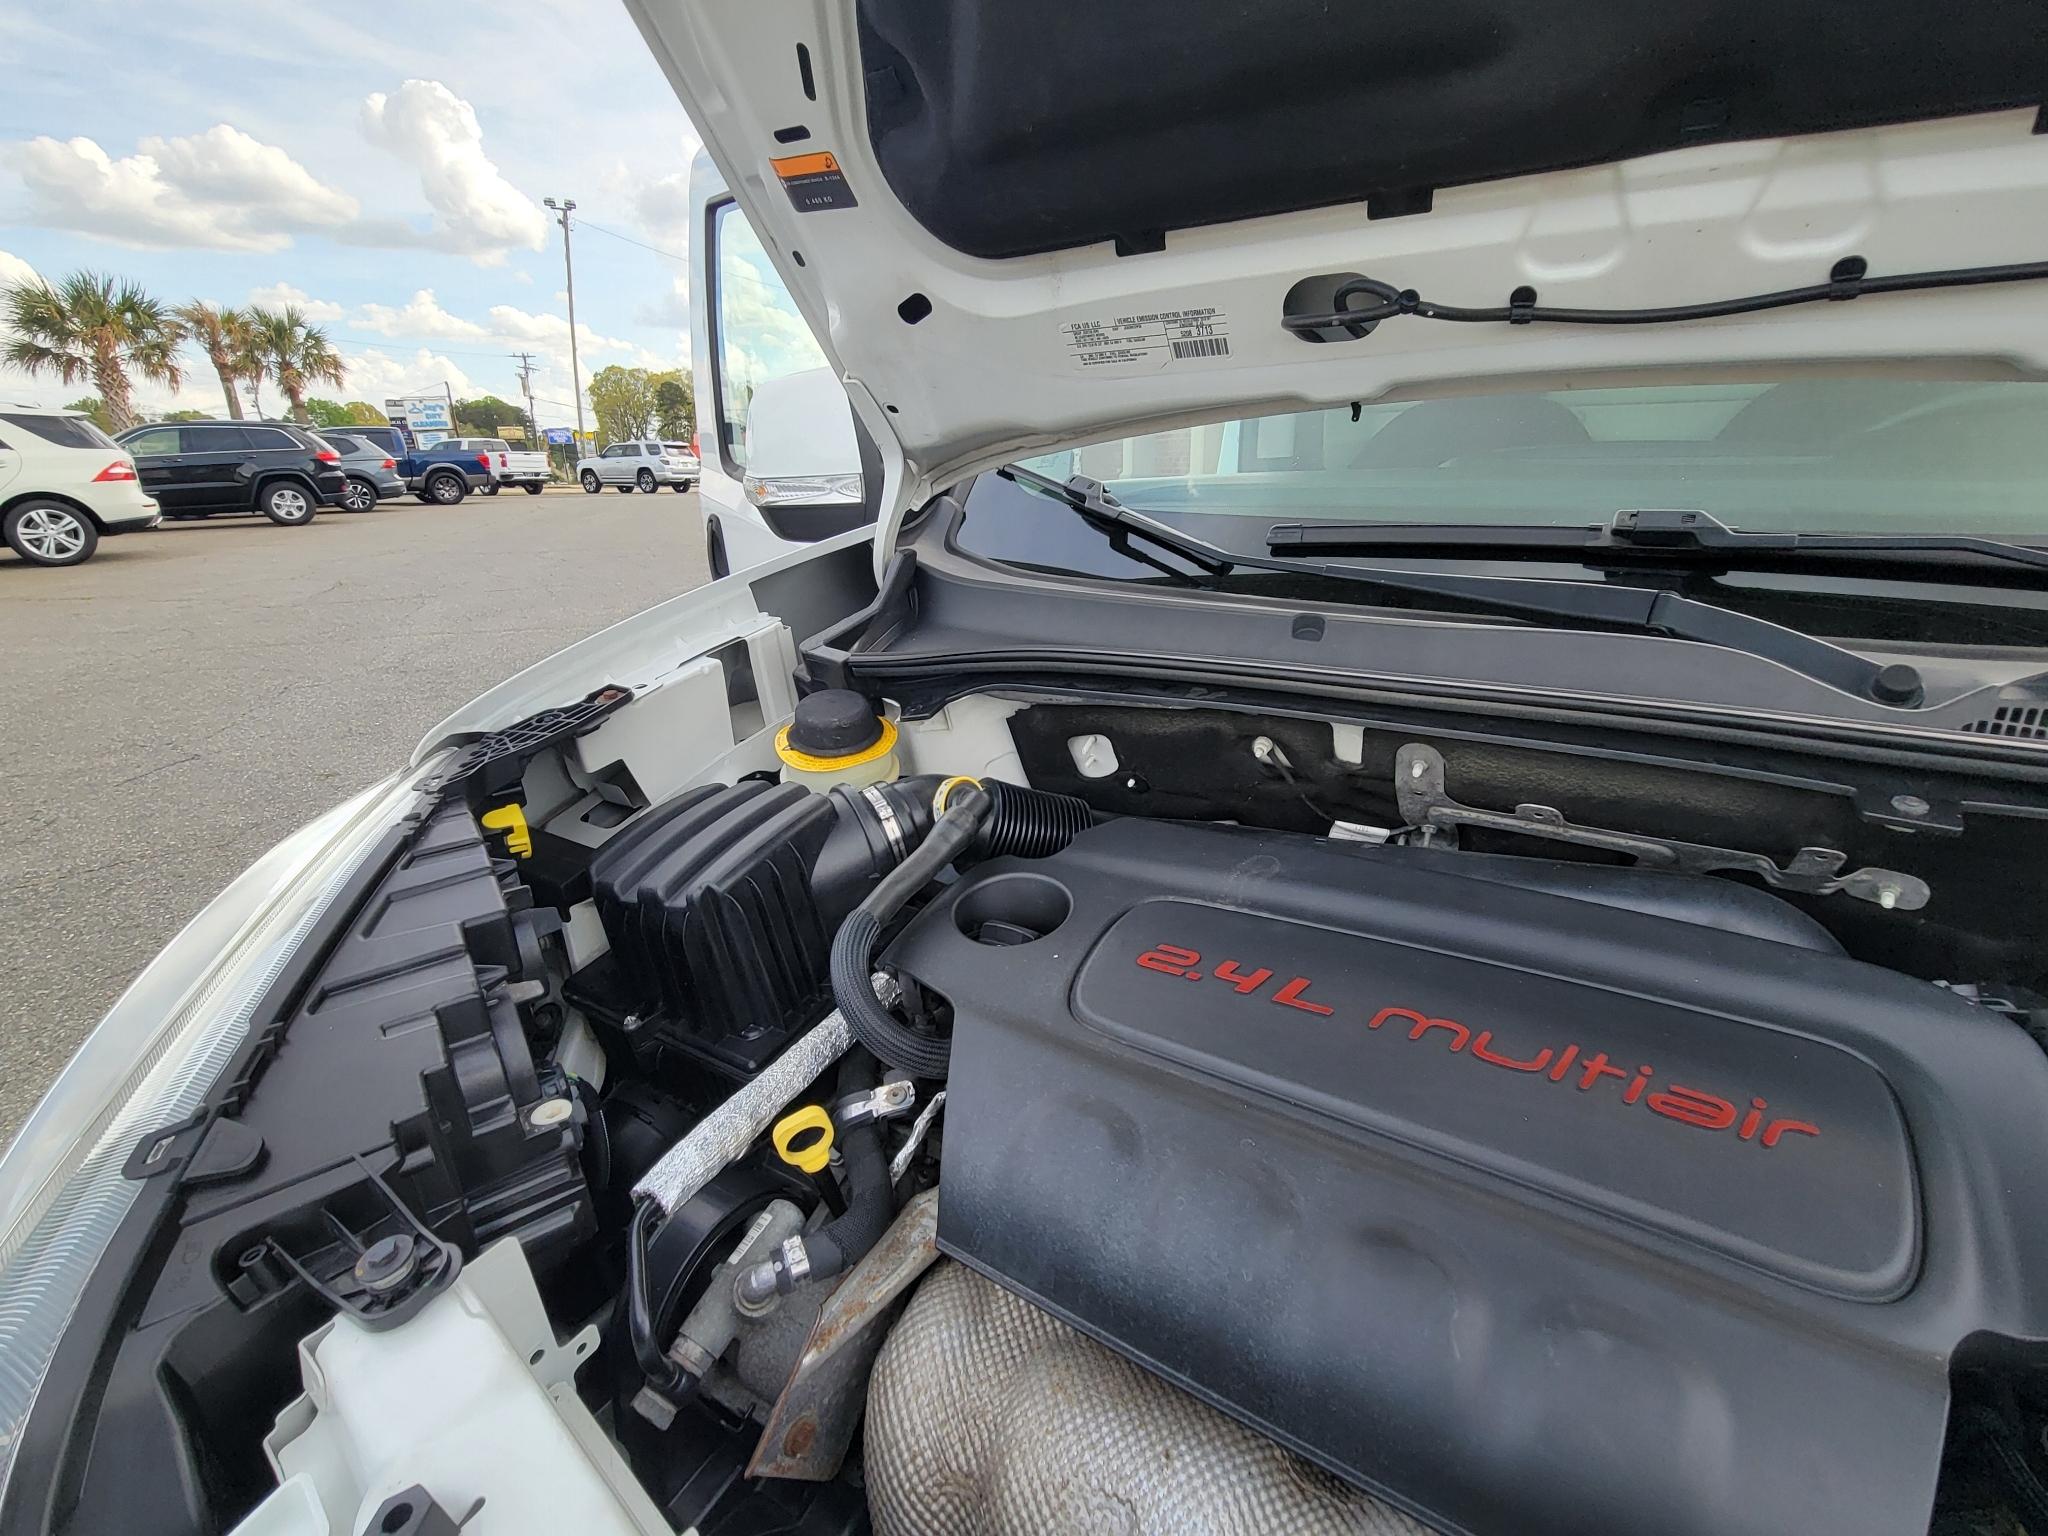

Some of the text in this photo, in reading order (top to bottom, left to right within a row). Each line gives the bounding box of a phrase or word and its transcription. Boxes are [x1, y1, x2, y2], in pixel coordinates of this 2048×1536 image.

[1091, 320, 1101, 328] LLC
[1116, 308, 1216, 325] VEHICLE EMISSION CONTROL INFORMATION
[1137, 944, 1820, 1147] 2.4L multiair
